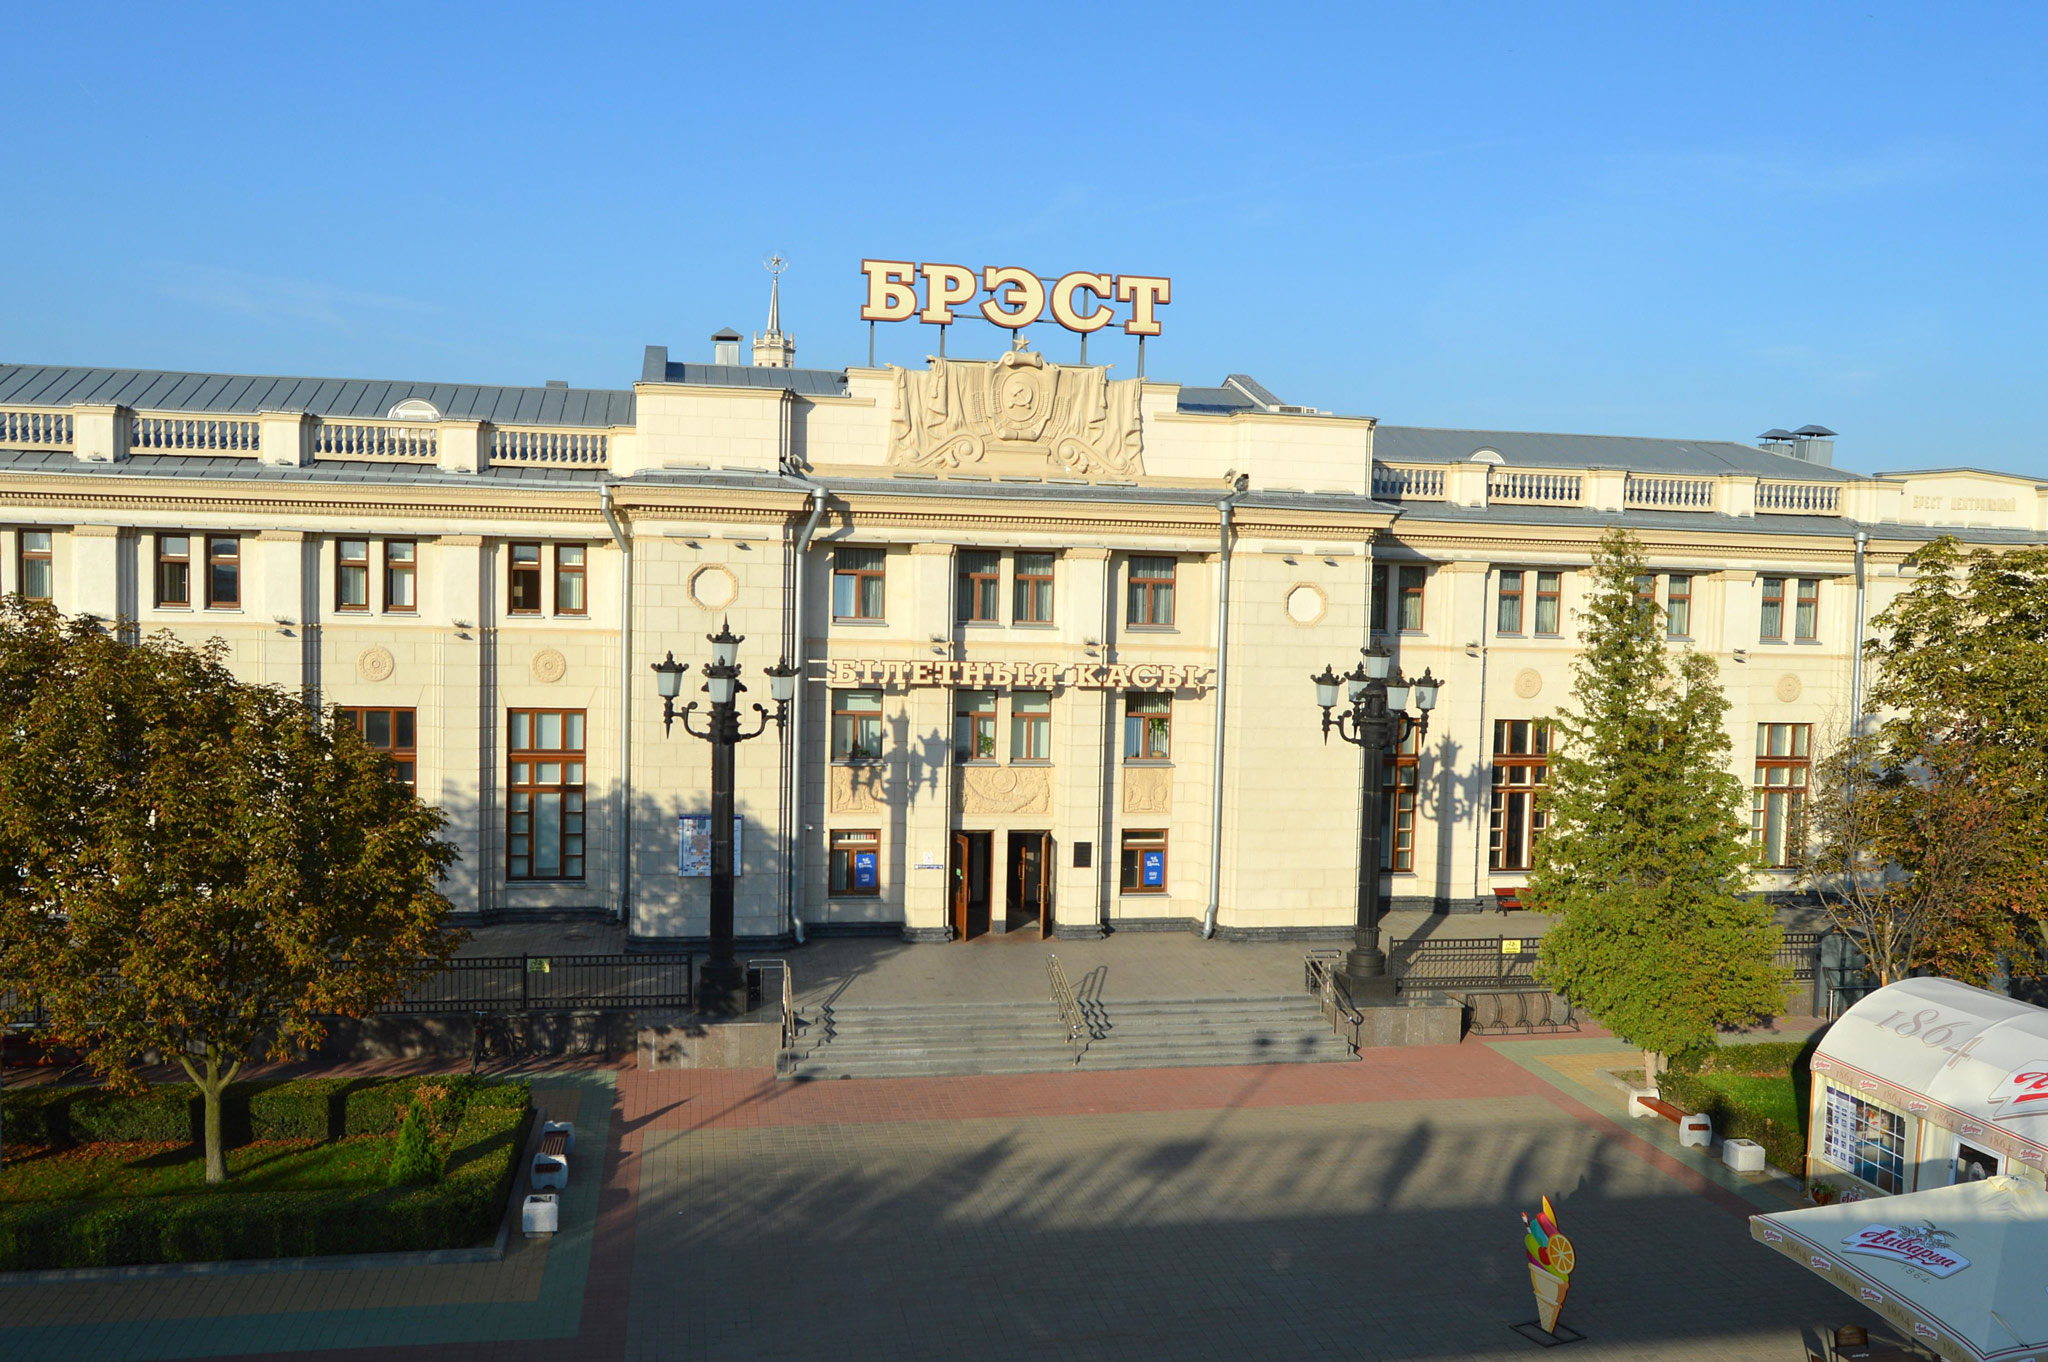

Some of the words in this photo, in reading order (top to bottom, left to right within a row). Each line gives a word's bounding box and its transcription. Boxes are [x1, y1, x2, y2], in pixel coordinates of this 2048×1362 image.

[861, 258, 1171, 336] БРЭСТ
[831, 659, 1058, 688] БІЛЕТНЫЯ
[1075, 662, 1200, 690] КАСЫ
[1875, 1008, 1985, 1070] 1864
